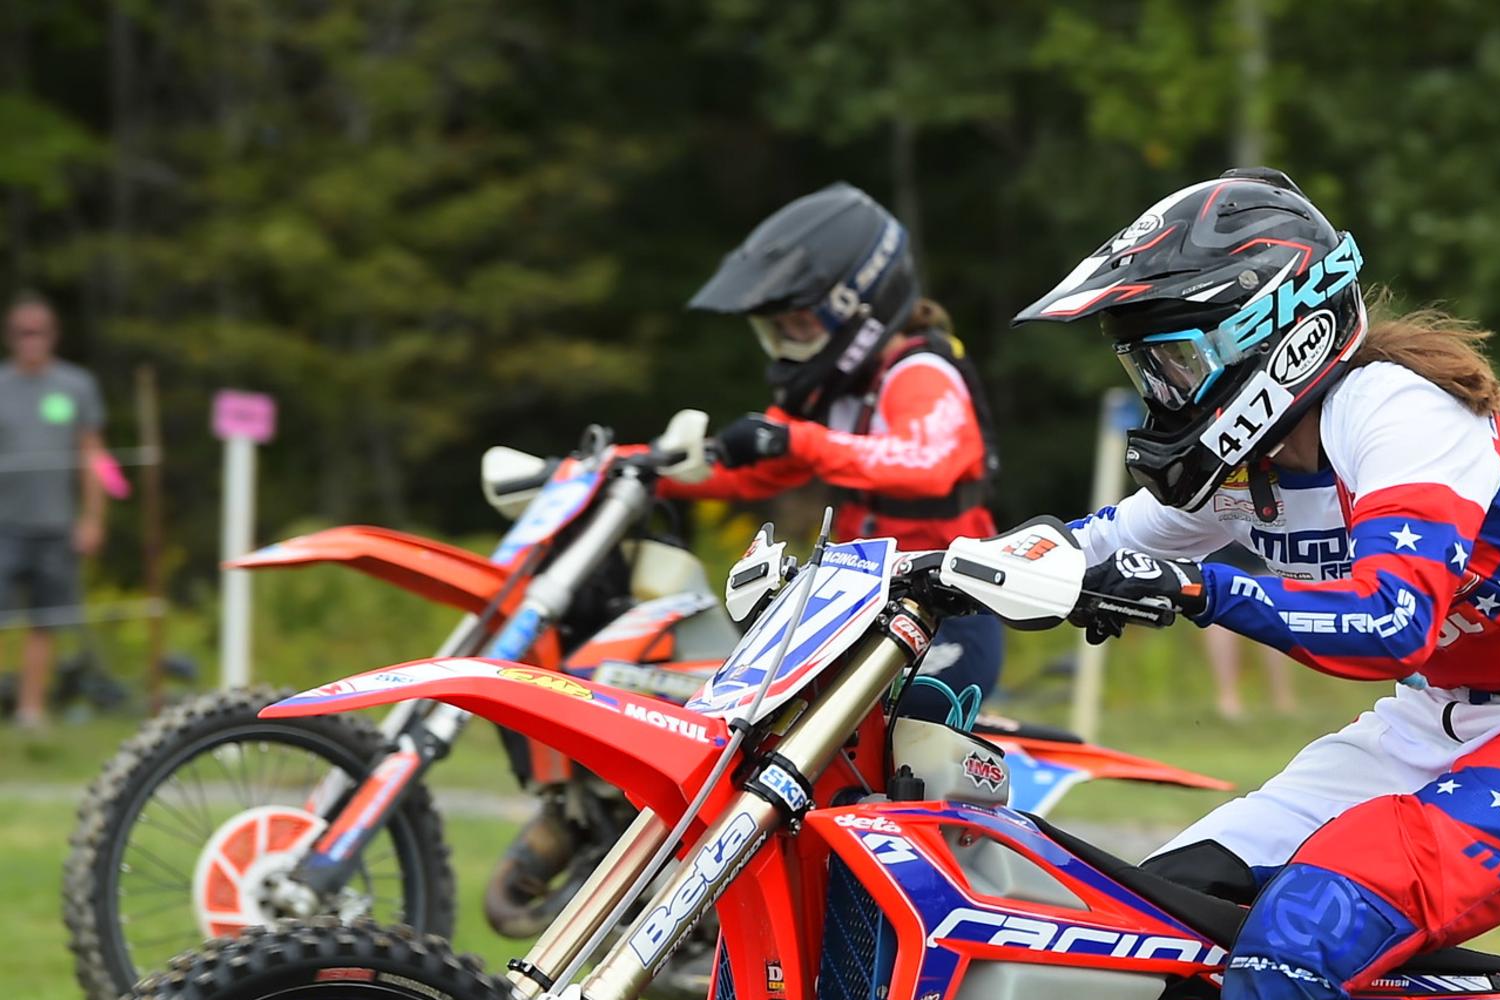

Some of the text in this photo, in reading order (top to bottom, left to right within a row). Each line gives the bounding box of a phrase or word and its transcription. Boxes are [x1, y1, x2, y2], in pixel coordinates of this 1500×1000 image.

[1278, 316, 1328, 383] Arai
[1218, 388, 1274, 458] 417
[624, 703, 710, 743] MOTUL
[966, 758, 1004, 782] IMS
[629, 811, 759, 969] Beta
[702, 831, 767, 914] SUSPENSION
